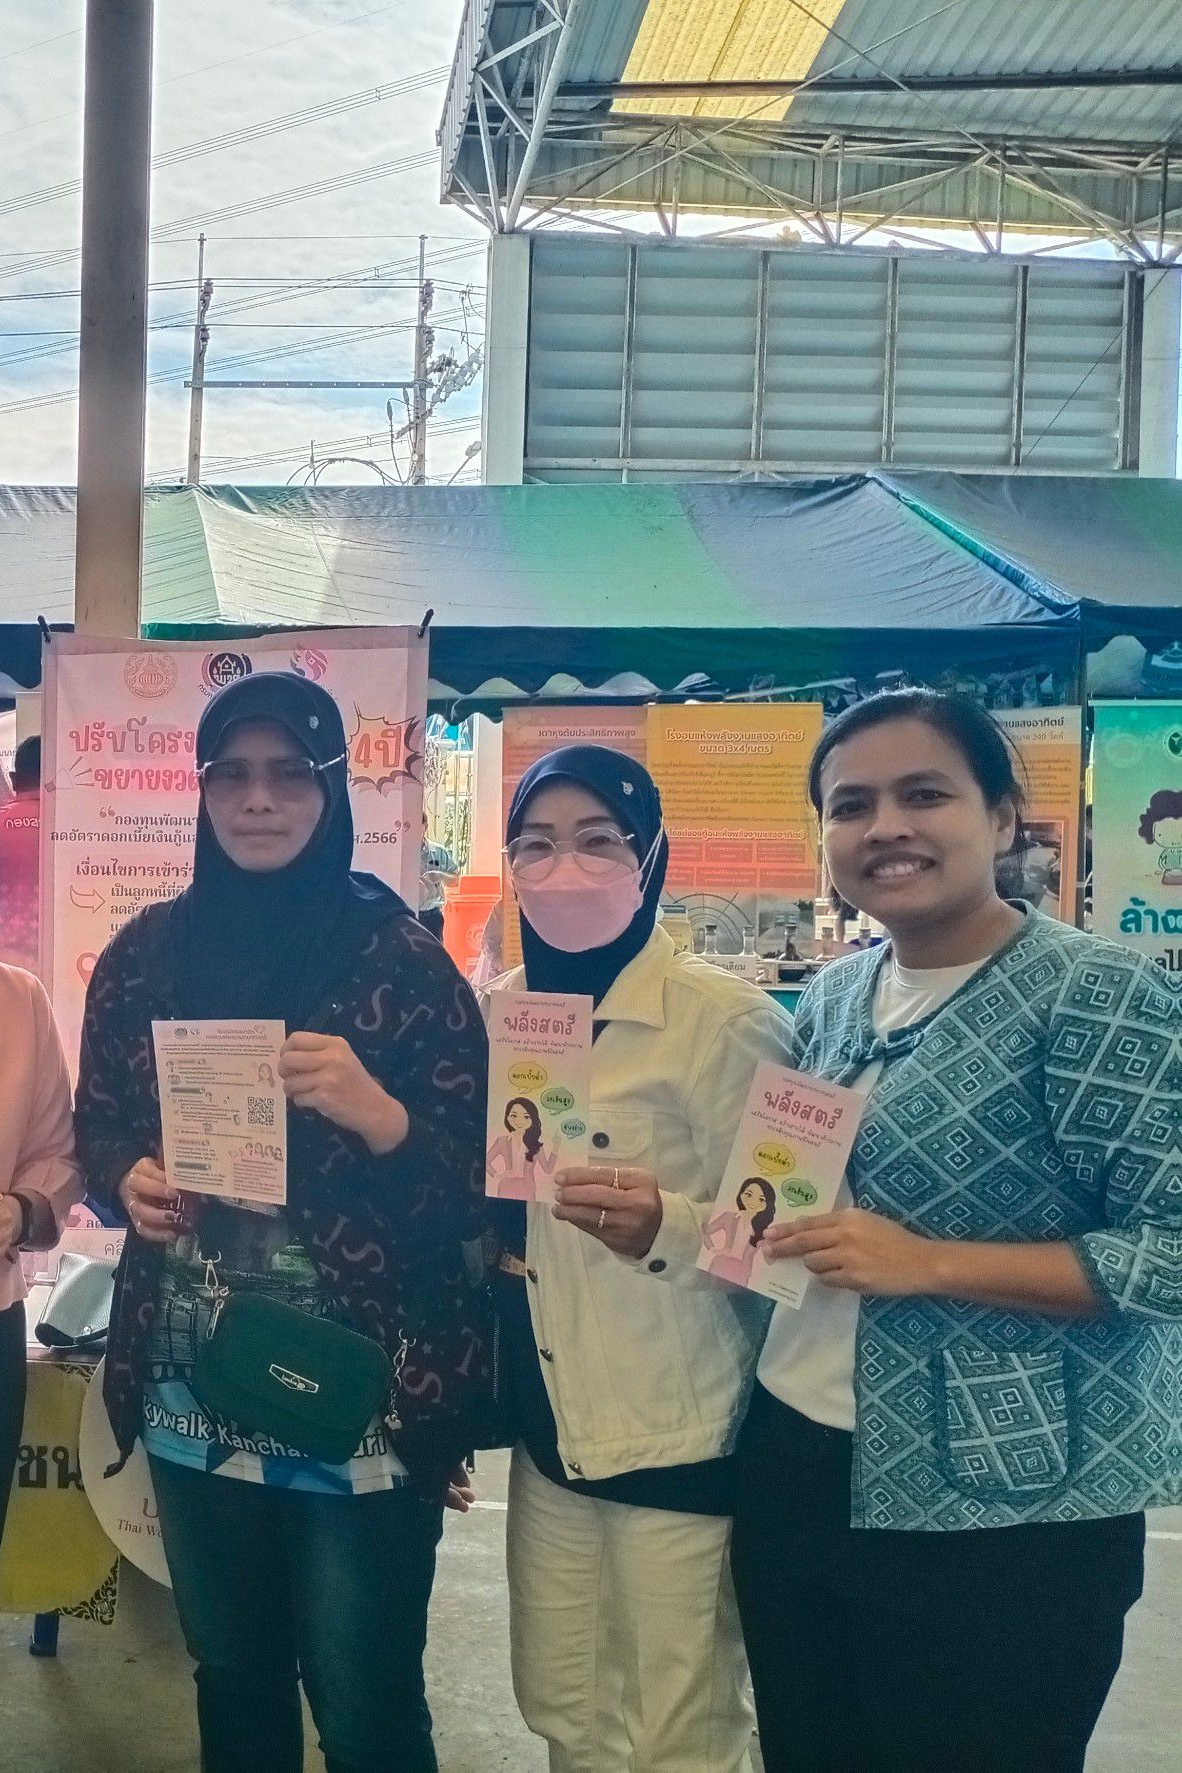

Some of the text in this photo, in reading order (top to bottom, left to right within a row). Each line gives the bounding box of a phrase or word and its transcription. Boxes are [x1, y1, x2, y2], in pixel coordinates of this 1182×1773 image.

[354, 724, 402, 769] 4ปี
[504, 1010, 576, 1036] พลังสตรี
[764, 1090, 843, 1129] พลังสตรี
[118, 1518, 142, 1534] Thai
